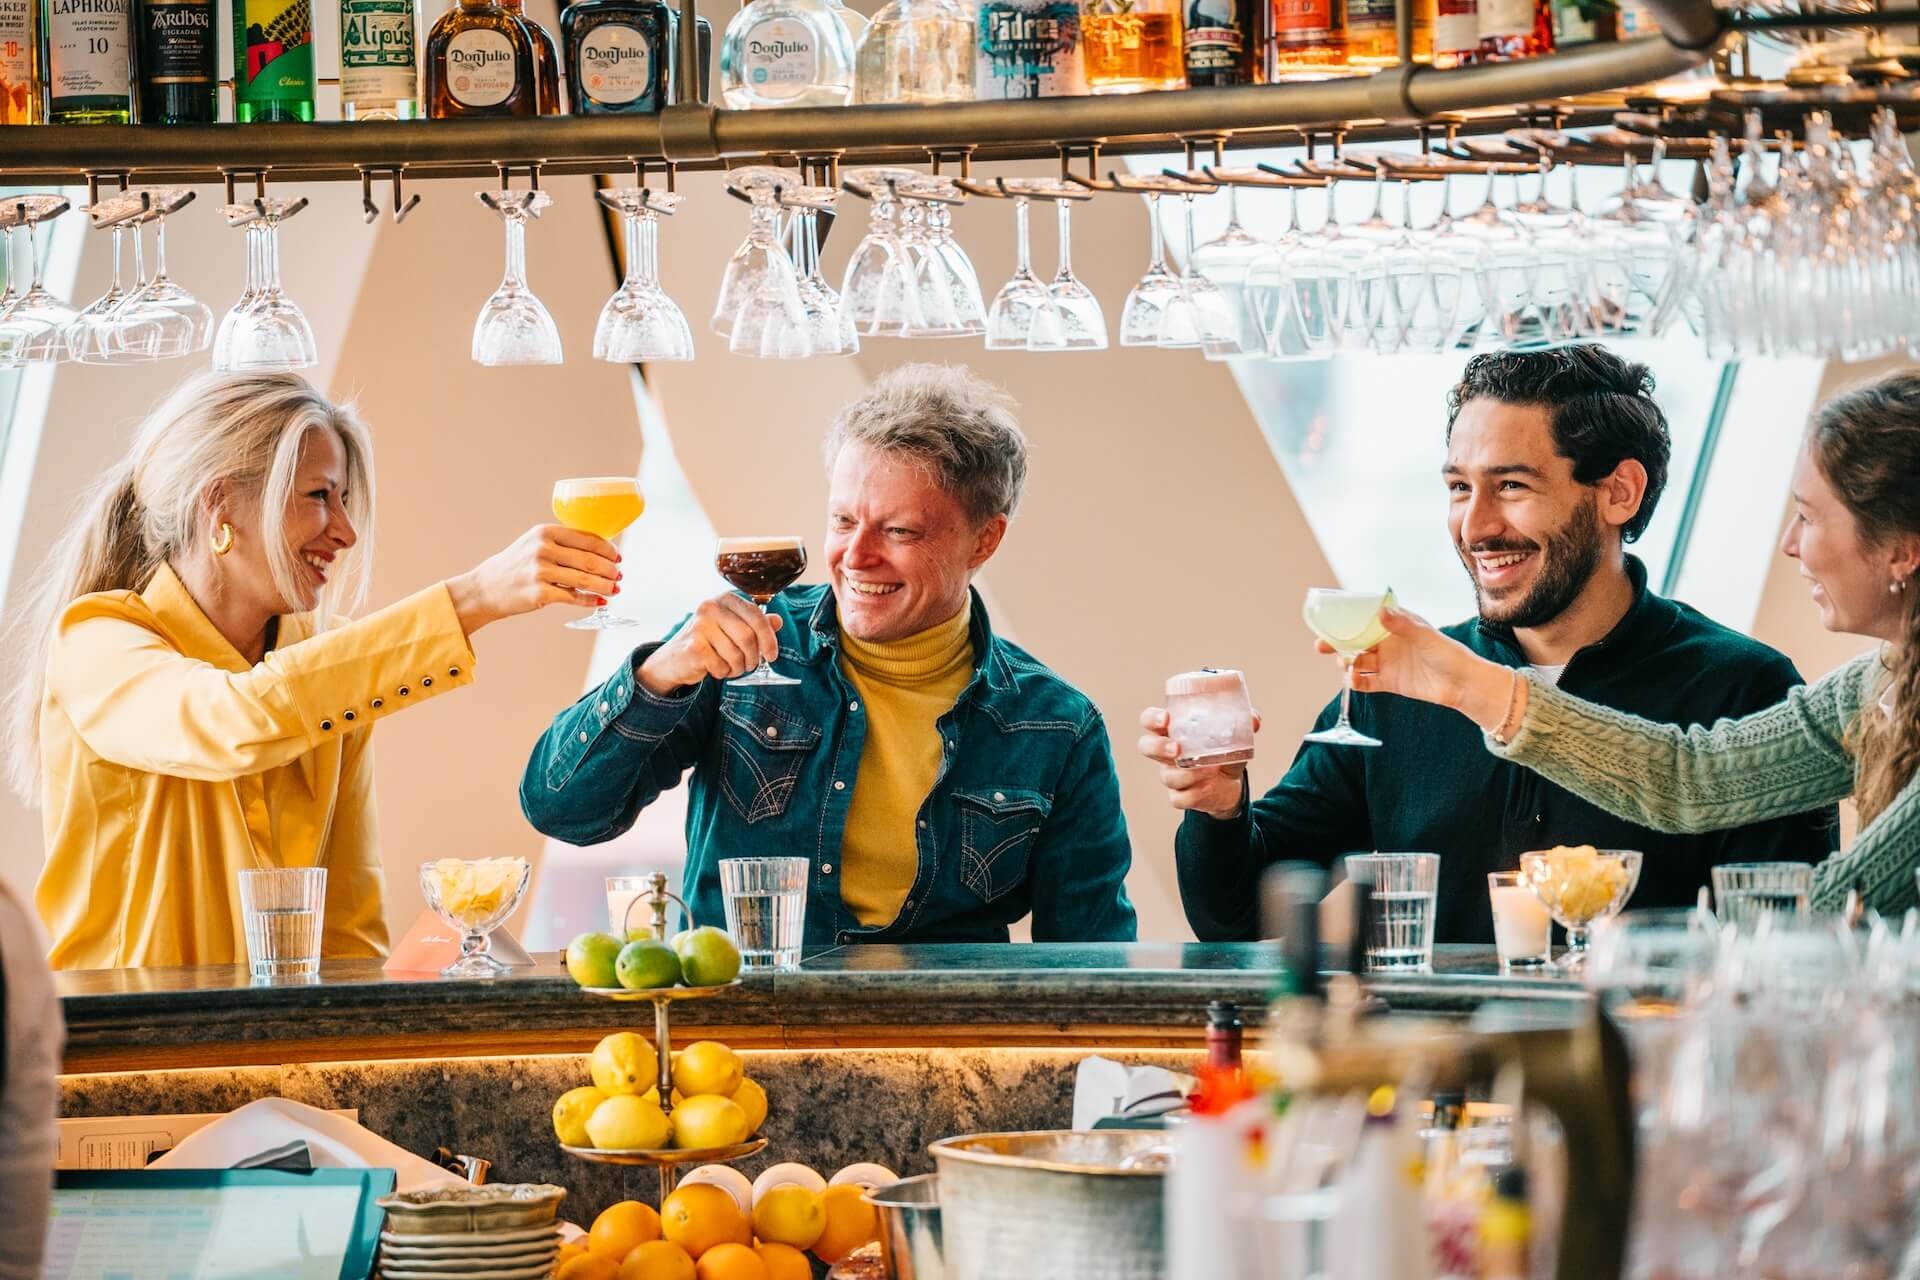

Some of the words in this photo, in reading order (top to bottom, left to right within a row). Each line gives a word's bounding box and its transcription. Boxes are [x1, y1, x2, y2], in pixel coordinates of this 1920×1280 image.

[344, 15, 412, 51] Alipús
[4, 41, 18, 57] 10
[88, 37, 109, 55] 10
